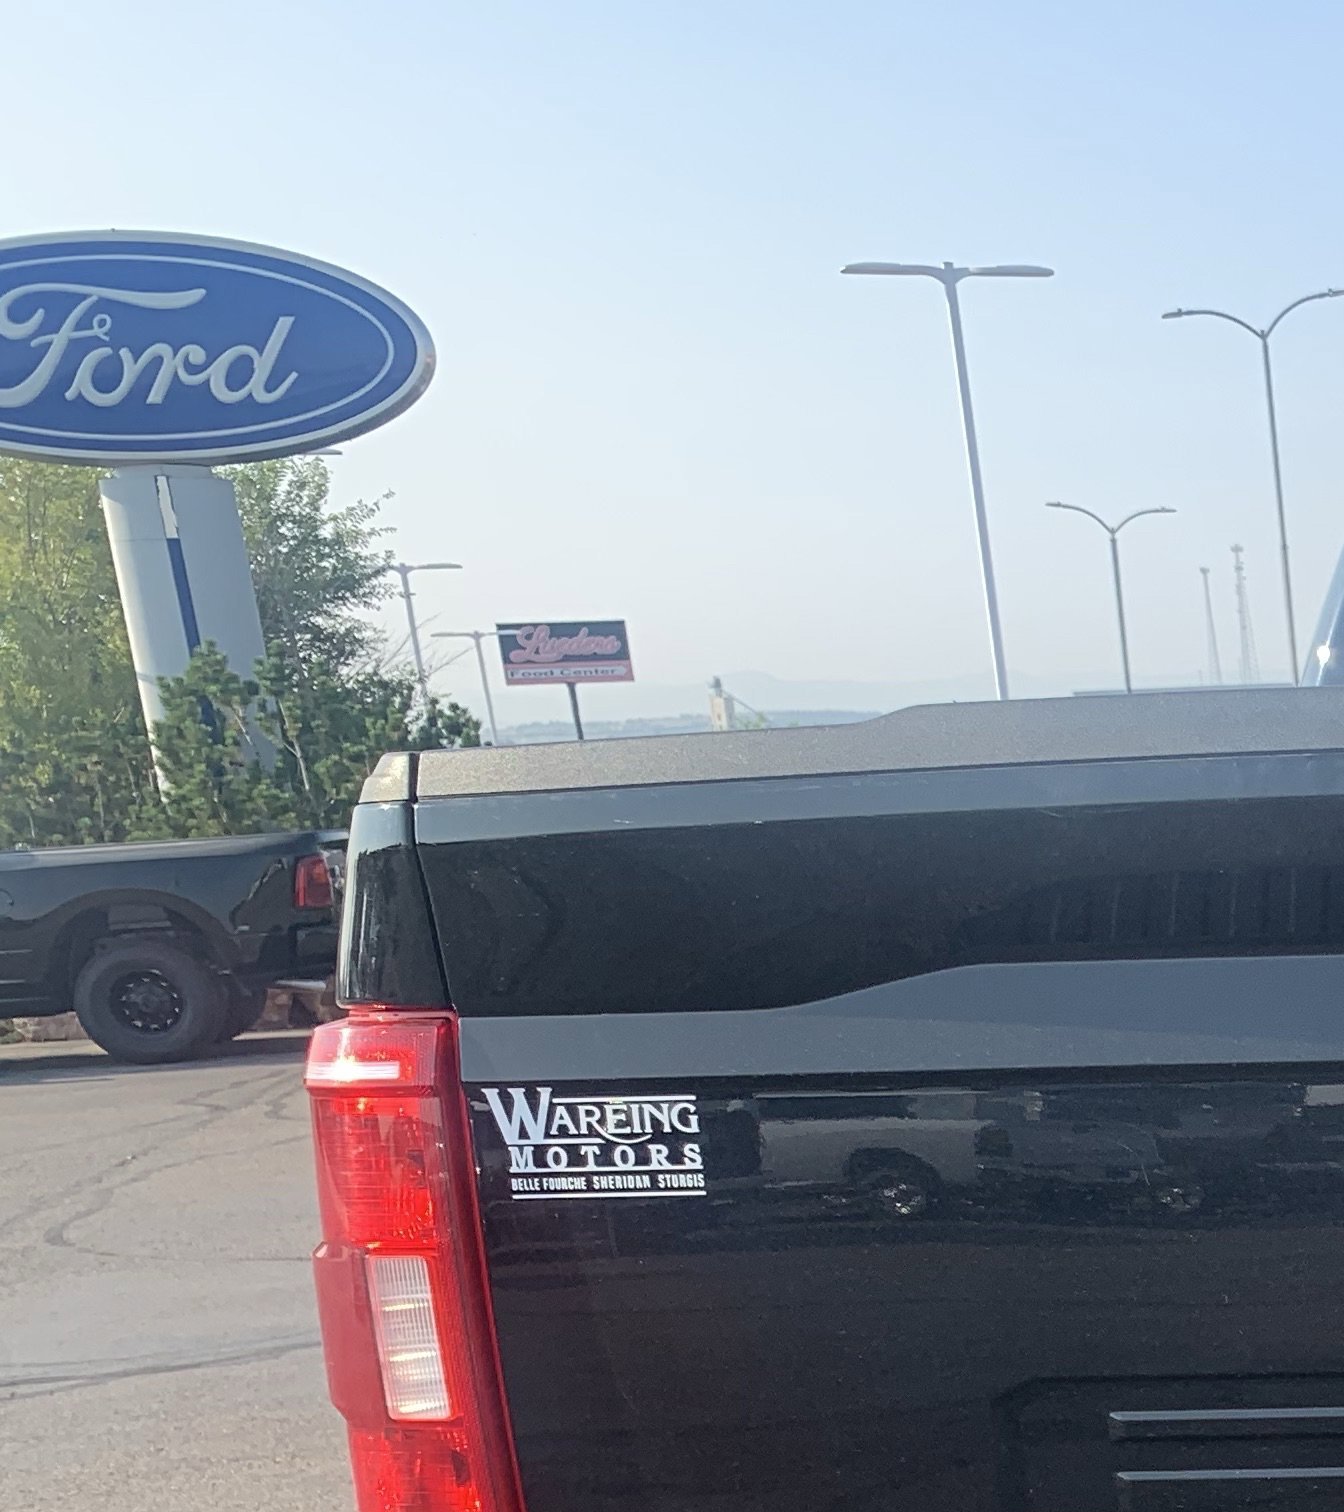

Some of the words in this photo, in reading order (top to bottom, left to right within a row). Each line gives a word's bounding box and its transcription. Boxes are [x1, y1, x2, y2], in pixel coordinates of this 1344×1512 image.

[0, 282, 299, 408] Ford
[510, 668, 555, 678] Food
[560, 666, 617, 677] Center
[481, 1087, 700, 1145] WAREING
[508, 1143, 704, 1171] MOTORS
[511, 1177, 541, 1192] BELLE
[542, 1176, 587, 1191] FOURCHE
[593, 1175, 651, 1190] SHERIDAN
[657, 1173, 705, 1189] STURGIS
